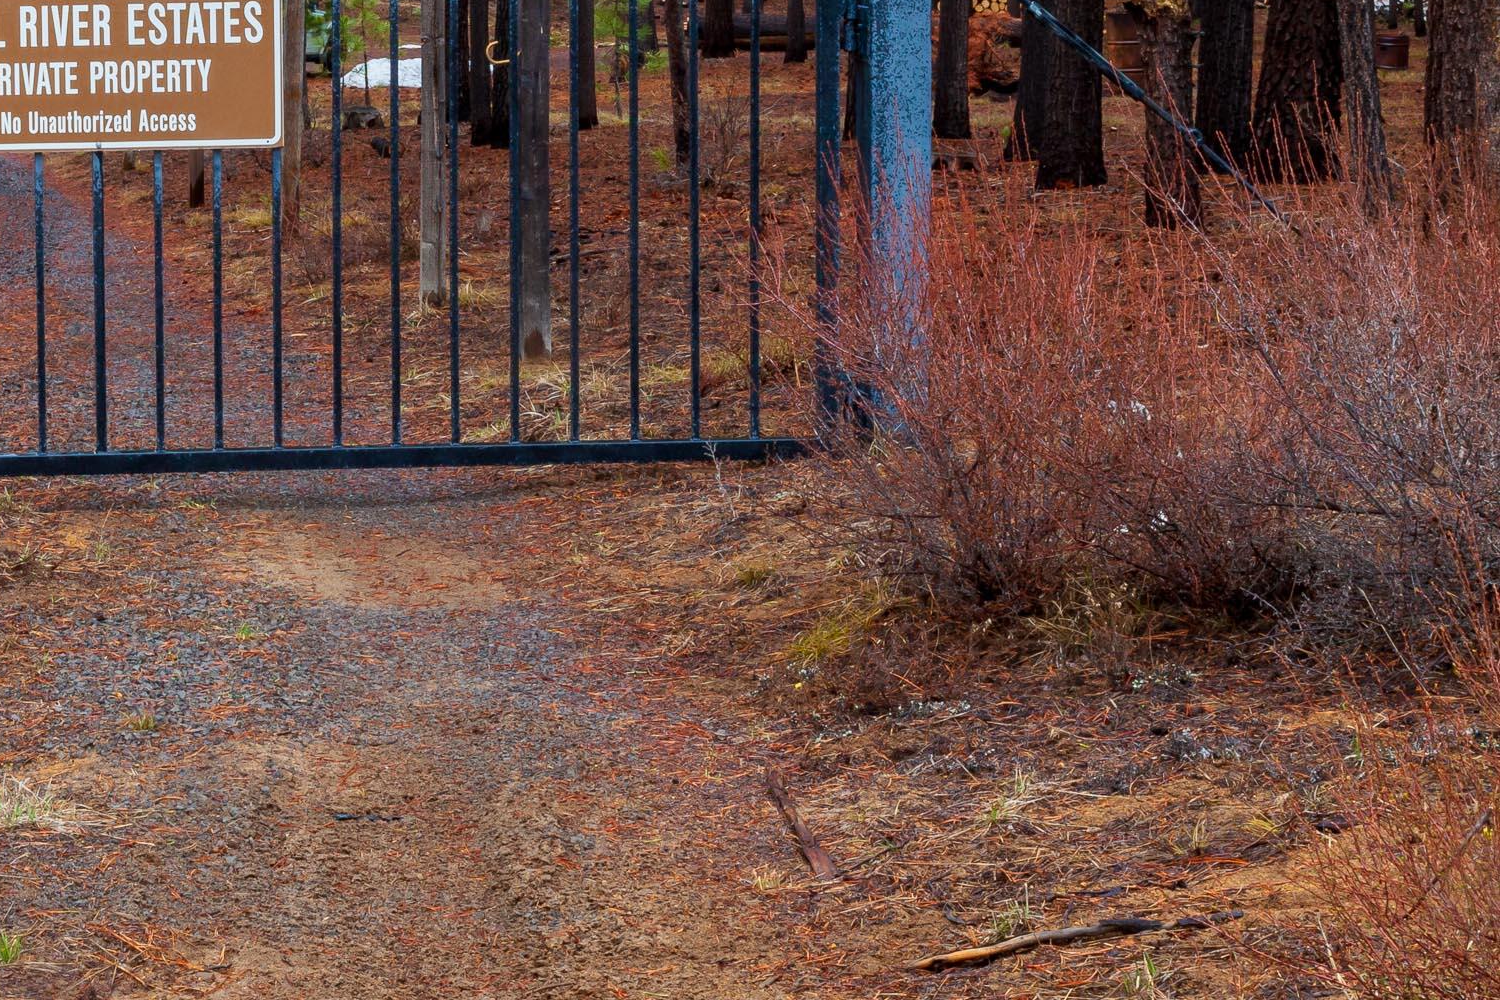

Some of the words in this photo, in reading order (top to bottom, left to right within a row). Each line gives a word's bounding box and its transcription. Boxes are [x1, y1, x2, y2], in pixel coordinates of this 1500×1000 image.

[20, 4, 111, 47] RIVER
[128, 1, 263, 45] ESTATES
[90, 59, 211, 94] PROPERTY
[1, 112, 21, 134] No
[29, 110, 132, 134] Unauthorized
[138, 109, 197, 133] Access
